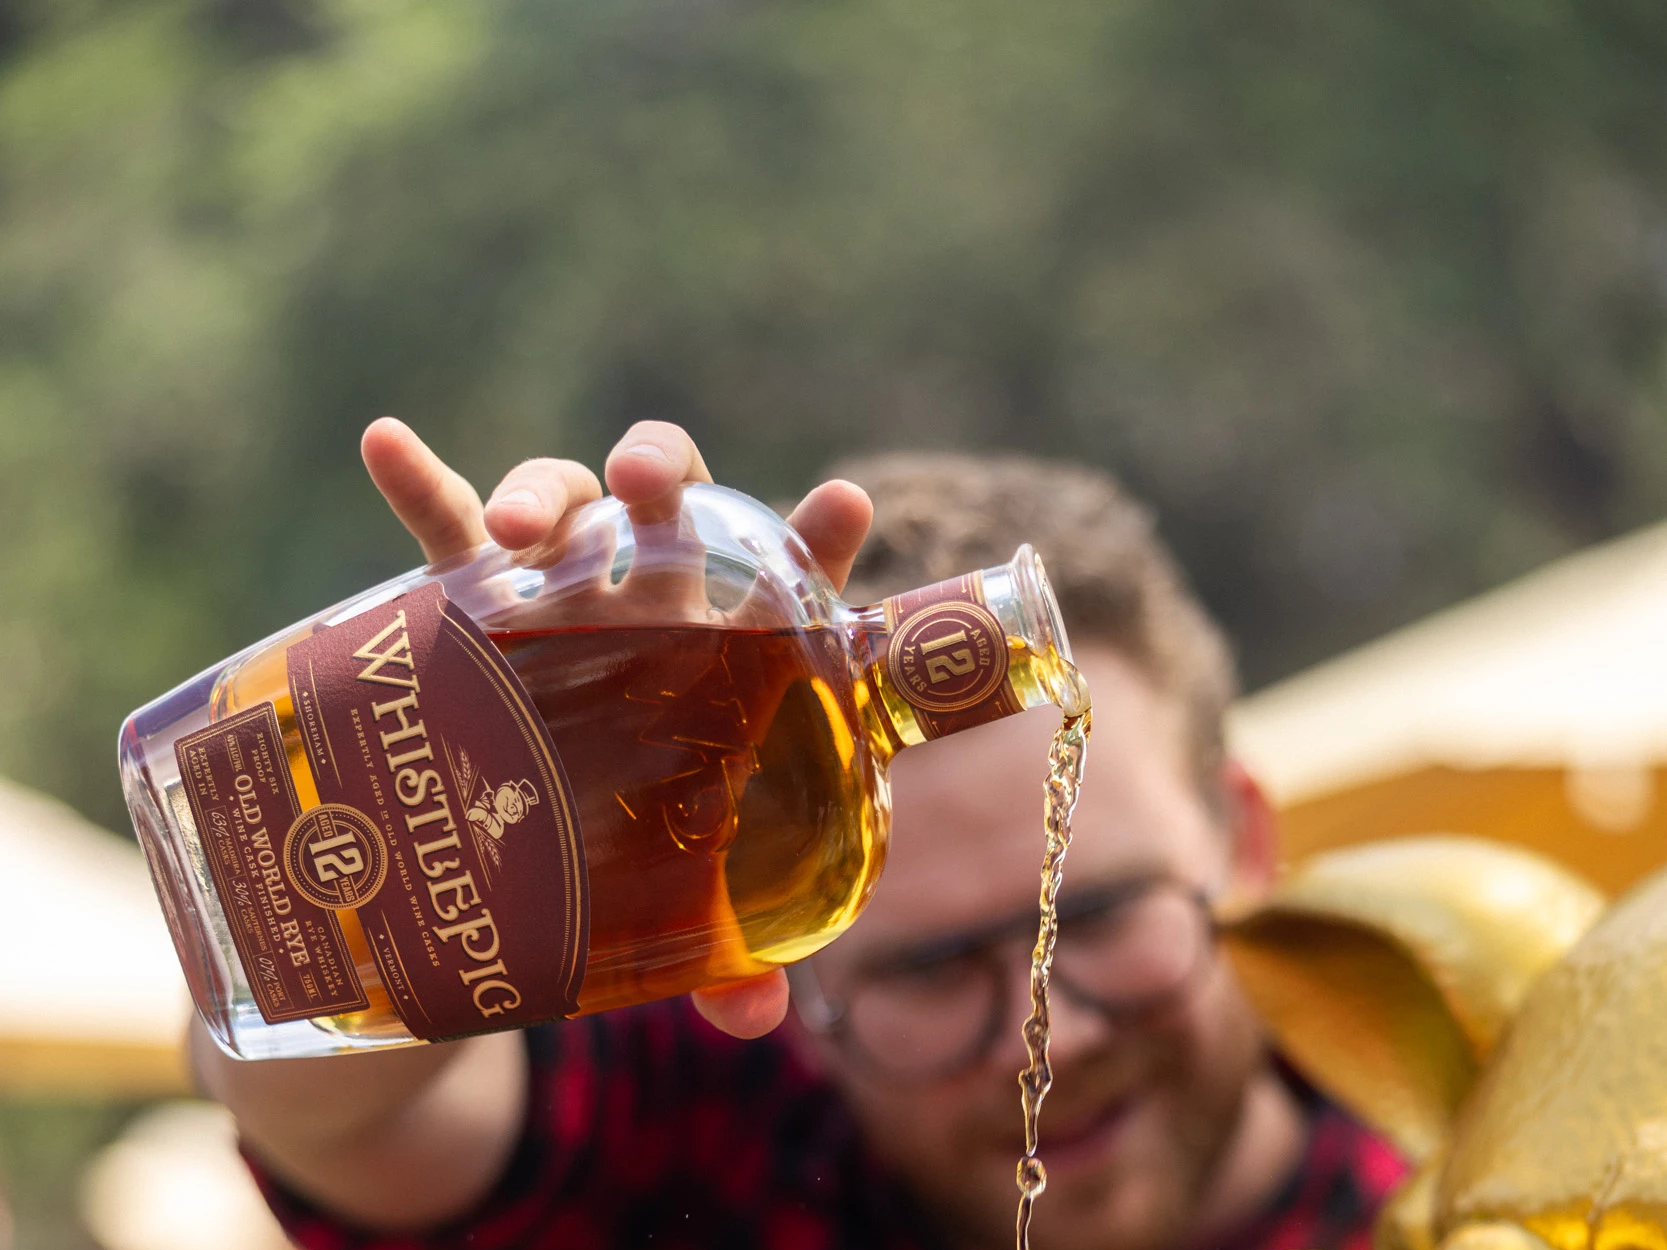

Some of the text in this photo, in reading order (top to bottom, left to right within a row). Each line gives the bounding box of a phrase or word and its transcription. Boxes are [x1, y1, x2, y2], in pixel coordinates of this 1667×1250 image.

[903, 628, 991, 692] AGED 12 YEARS
[302, 699, 324, 756] SHOREHAM
[188, 749, 208, 796] AGED IN
[197, 746, 219, 802] EXPERTLY
[250, 748, 266, 784] PROOF
[255, 731, 279, 795] EIGHTY SIX
[210, 808, 230, 840] 63%
[350, 707, 373, 769] EXPERTLY
[369, 773, 384, 805] AGED
[384, 823, 397, 847] OLD
[393, 850, 413, 891] WORLD
[408, 895, 425, 927] WINE
[420, 930, 440, 967] CASKS
[352, 609, 521, 1017] WHISTLEPIG
[217, 839, 231, 865] CASKS
[224, 837, 241, 875] MADEIRA
[231, 808, 281, 942] WINE CASK FINISHED
[232, 772, 311, 968] OLD WORLD RYE
[308, 812, 364, 902] AGED 12 YEARS
[232, 877, 252, 908] 30%
[240, 908, 254, 934] CASKS
[247, 906, 268, 951] SAUTERNES
[304, 919, 338, 997] RYE WHISKEY
[316, 925, 343, 987] CANADIAN
[382, 946, 405, 991] VERMONT
[266, 983, 280, 1007] CASKS
[273, 981, 285, 1001] PORT
